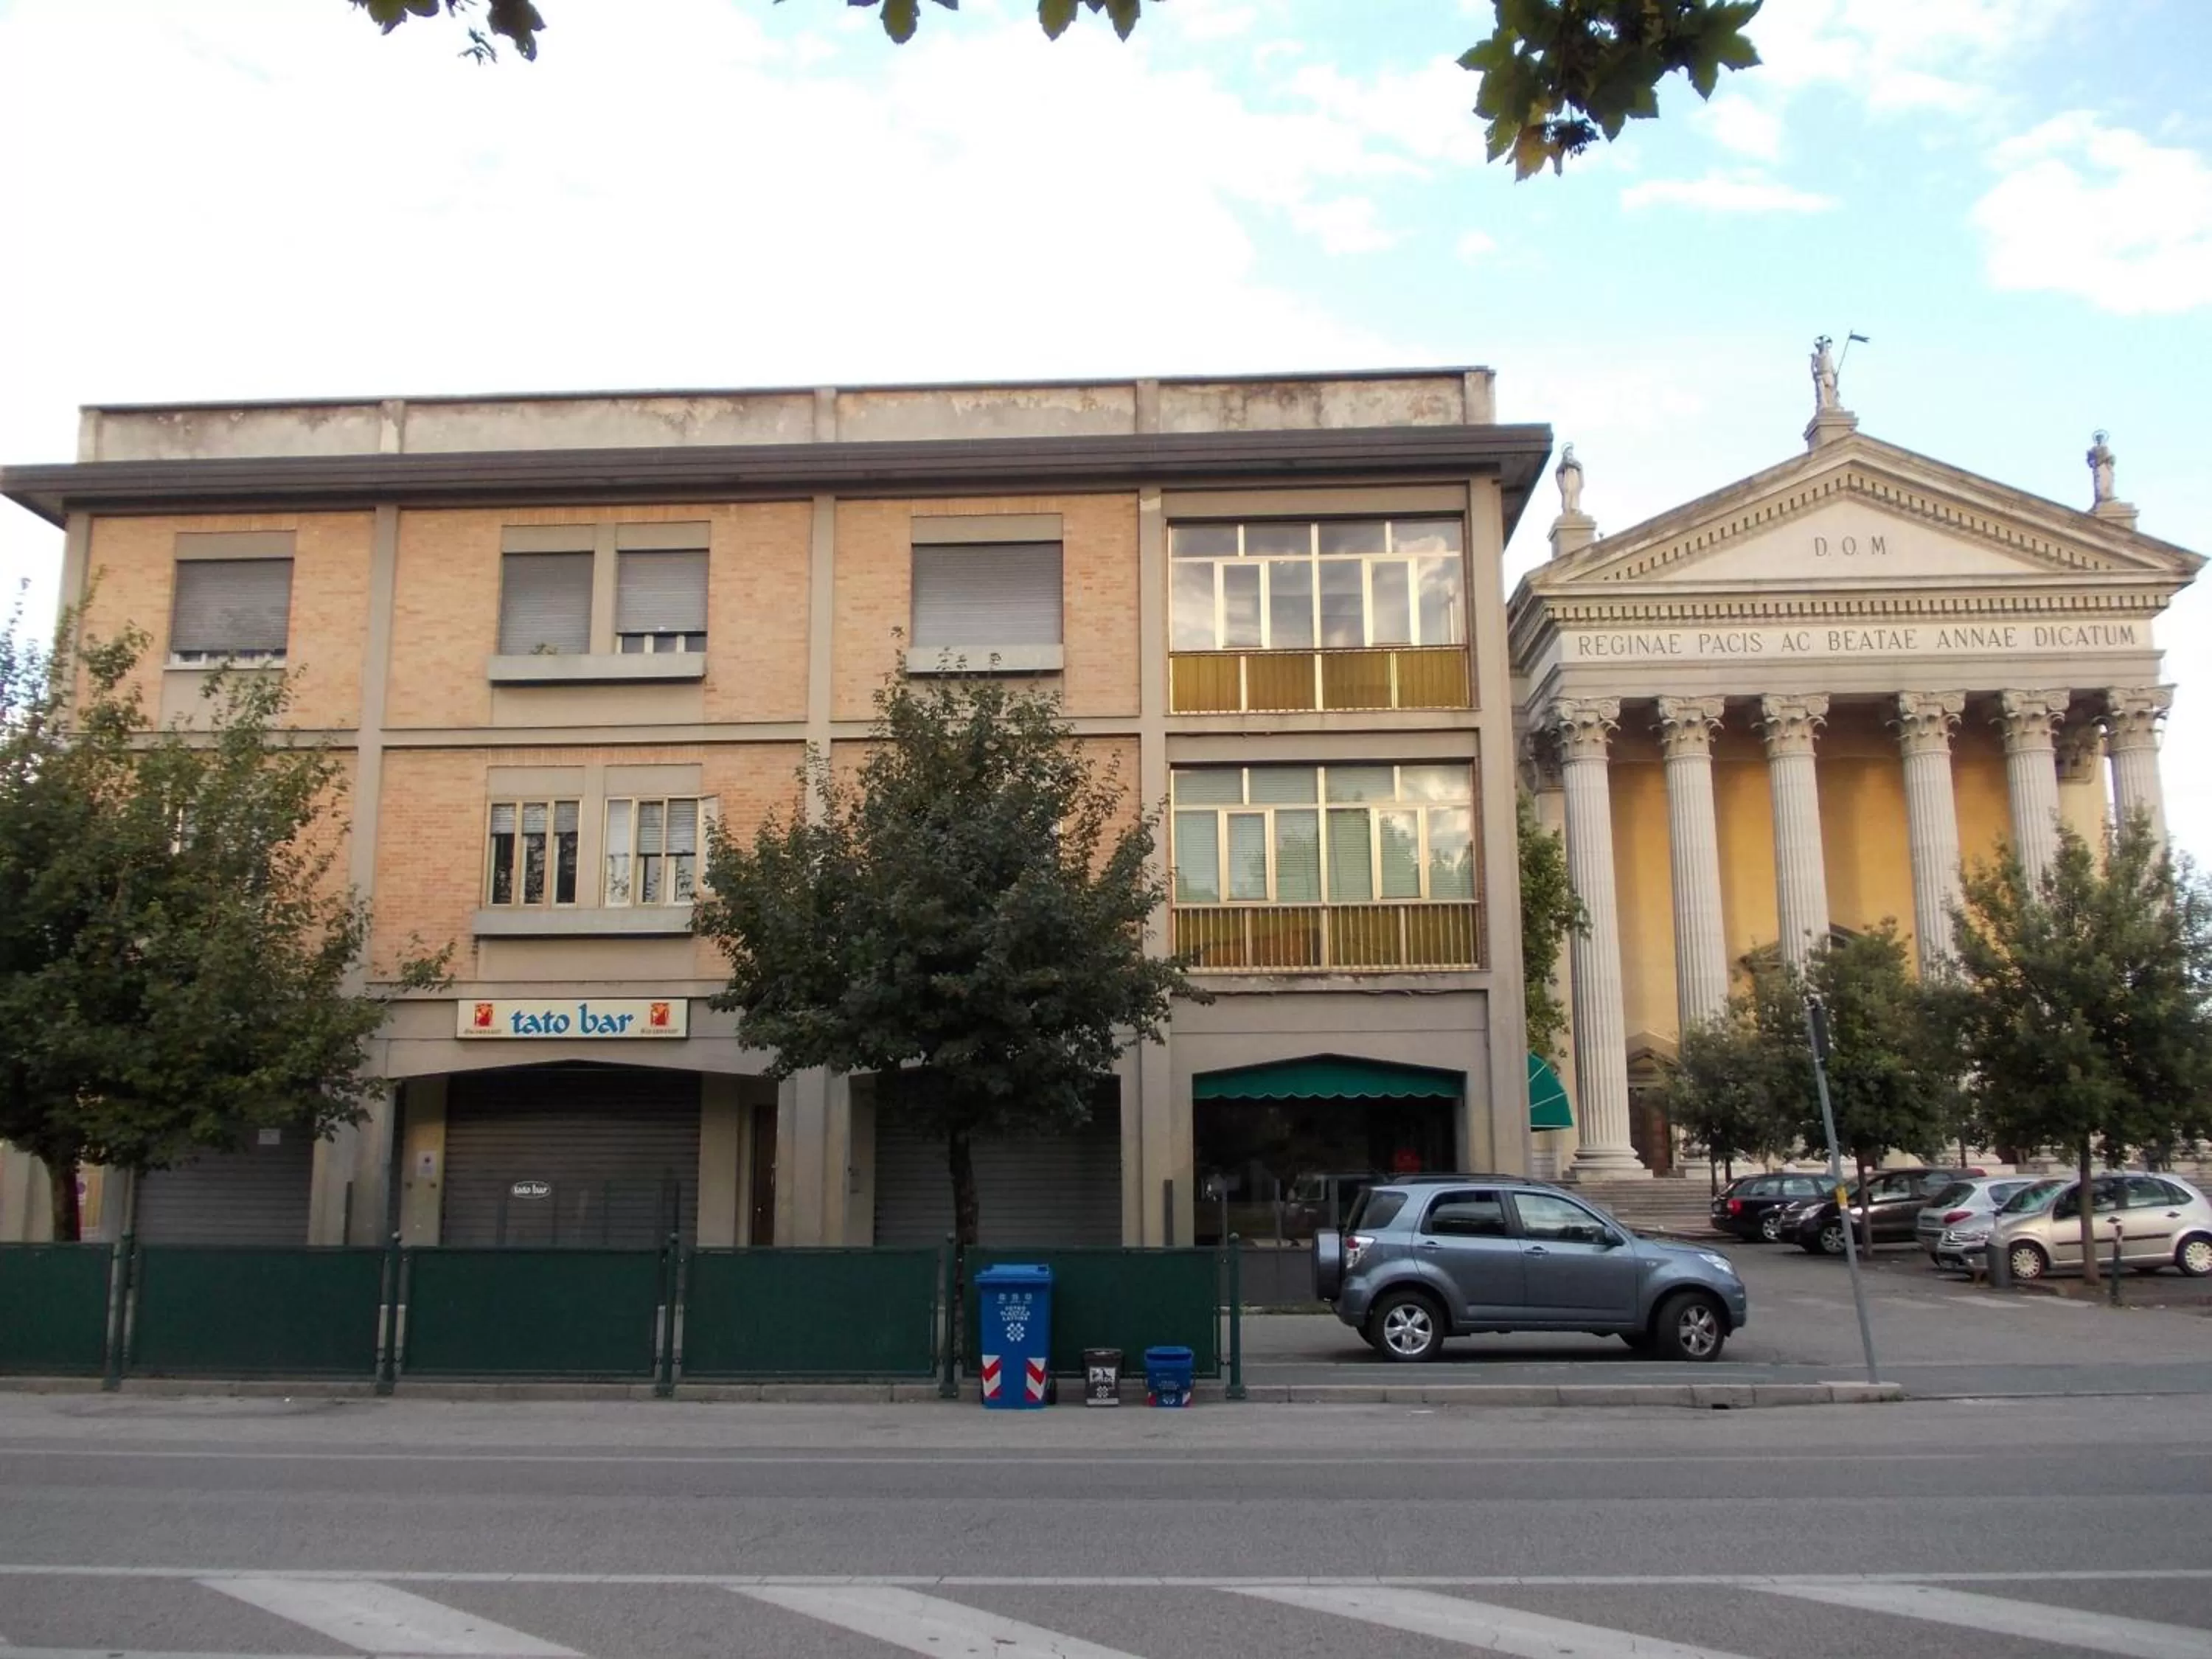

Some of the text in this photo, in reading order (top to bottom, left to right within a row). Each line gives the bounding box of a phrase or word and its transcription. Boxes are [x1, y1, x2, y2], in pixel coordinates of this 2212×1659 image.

[1578, 625, 2135, 655] REGINAE PACIS AC BEATAE ANNAE DICATUM
[510, 1003, 633, 1034] tato bar
